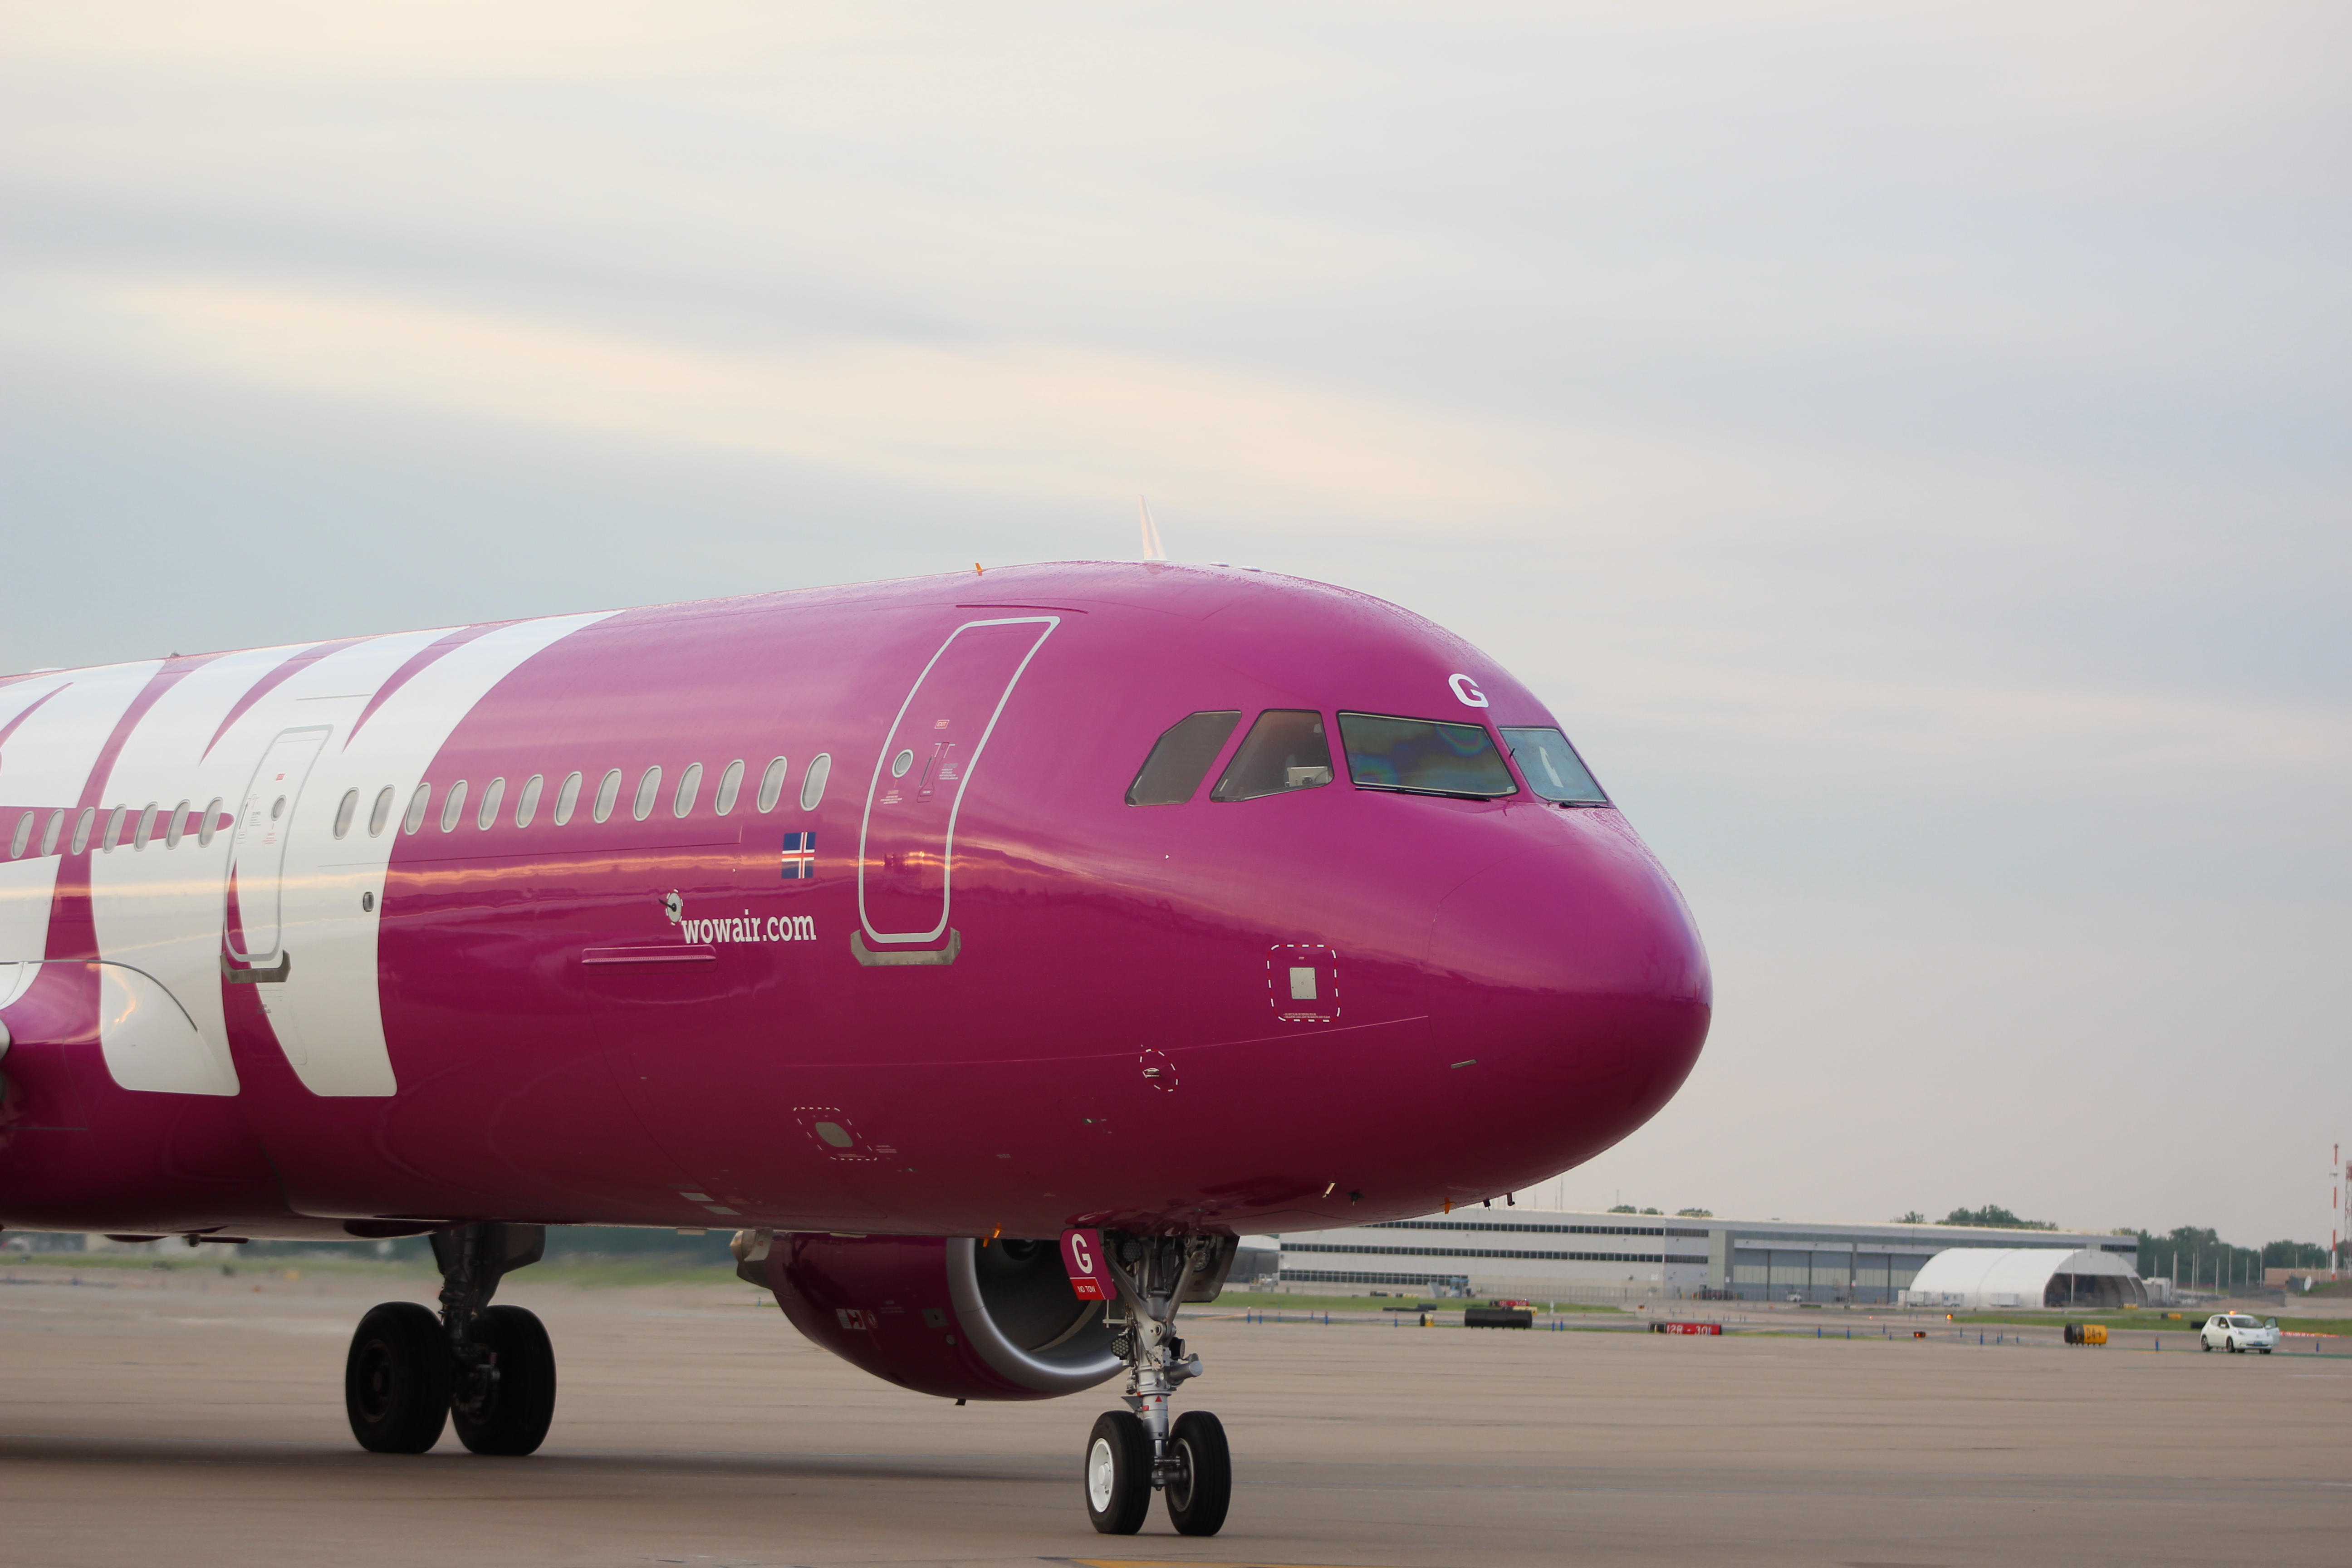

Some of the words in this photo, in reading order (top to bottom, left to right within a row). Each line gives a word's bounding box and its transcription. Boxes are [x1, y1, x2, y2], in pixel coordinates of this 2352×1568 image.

[1448, 673, 1489, 708] G
[681, 909, 817, 944] wowair.com
[1072, 1233, 1093, 1274] G
[2086, 1328, 2096, 1339] D4
